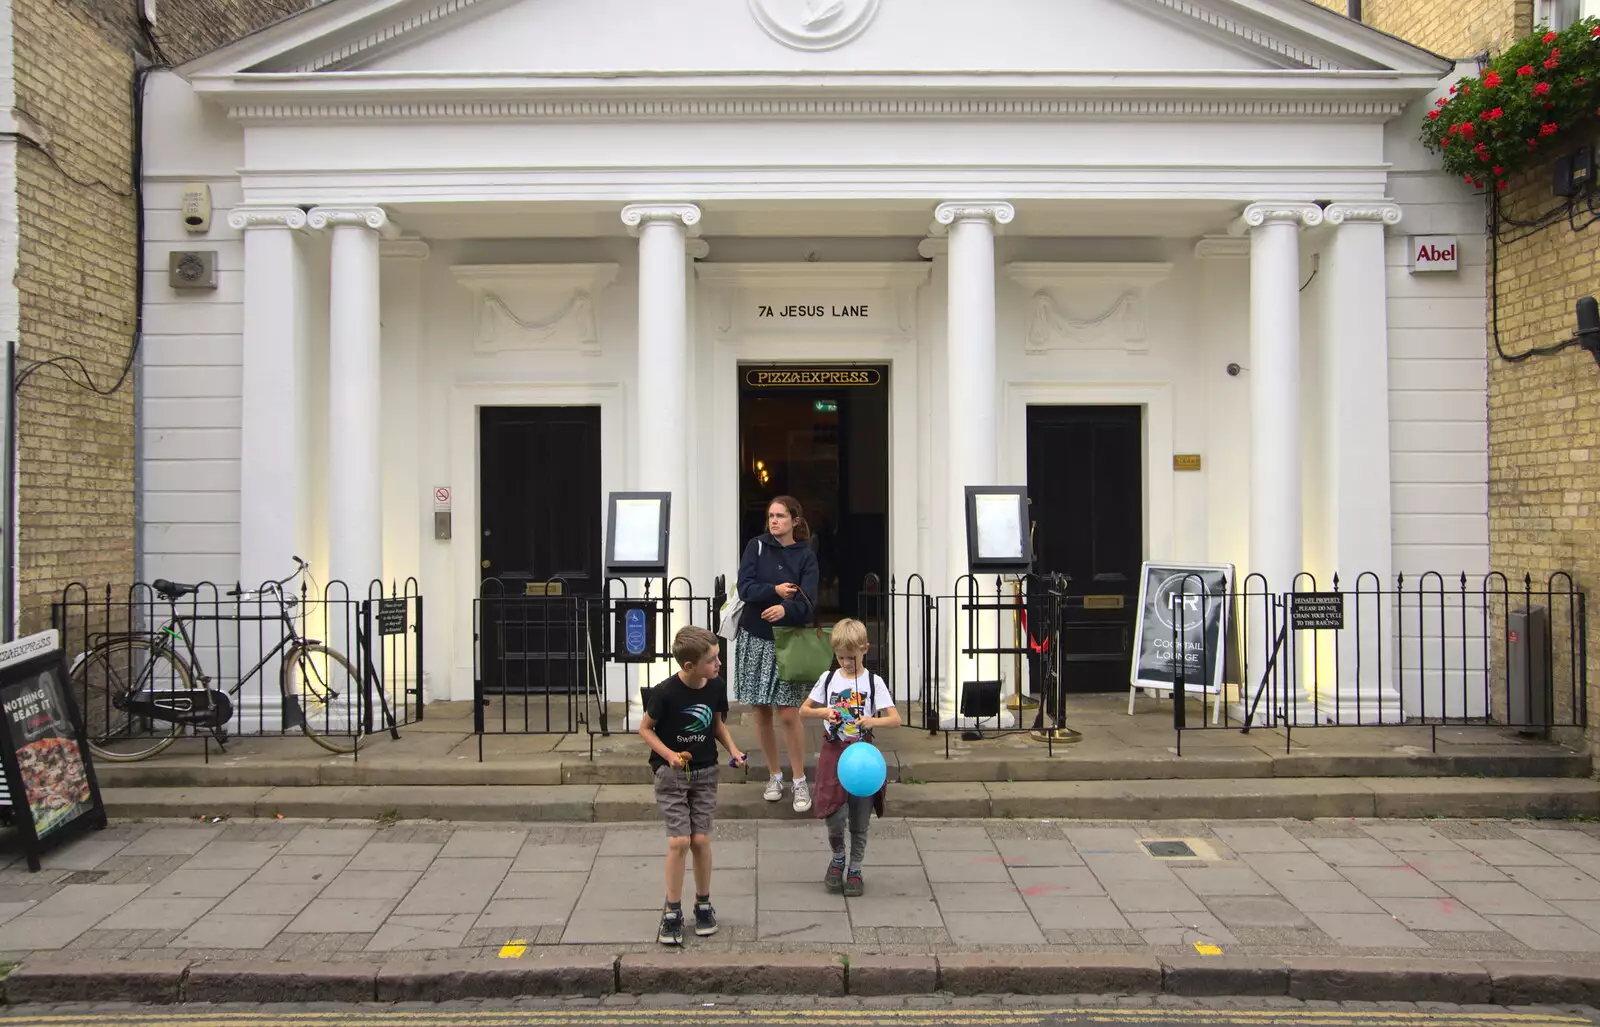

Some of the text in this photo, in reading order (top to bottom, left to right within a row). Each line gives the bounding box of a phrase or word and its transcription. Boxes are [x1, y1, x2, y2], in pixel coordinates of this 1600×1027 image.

[1416, 244, 1455, 261] Abel
[758, 305, 869, 317] 7A JESUS LANE
[758, 372, 869, 383] PIZZAEXPRESS
[0, 636, 52, 661] ZAEXPRESS
[1156, 650, 1199, 662] LOUNGE
[3, 689, 46, 713] NOTHING
[12, 704, 40, 722] BEATS
[41, 699, 52, 710] IT
